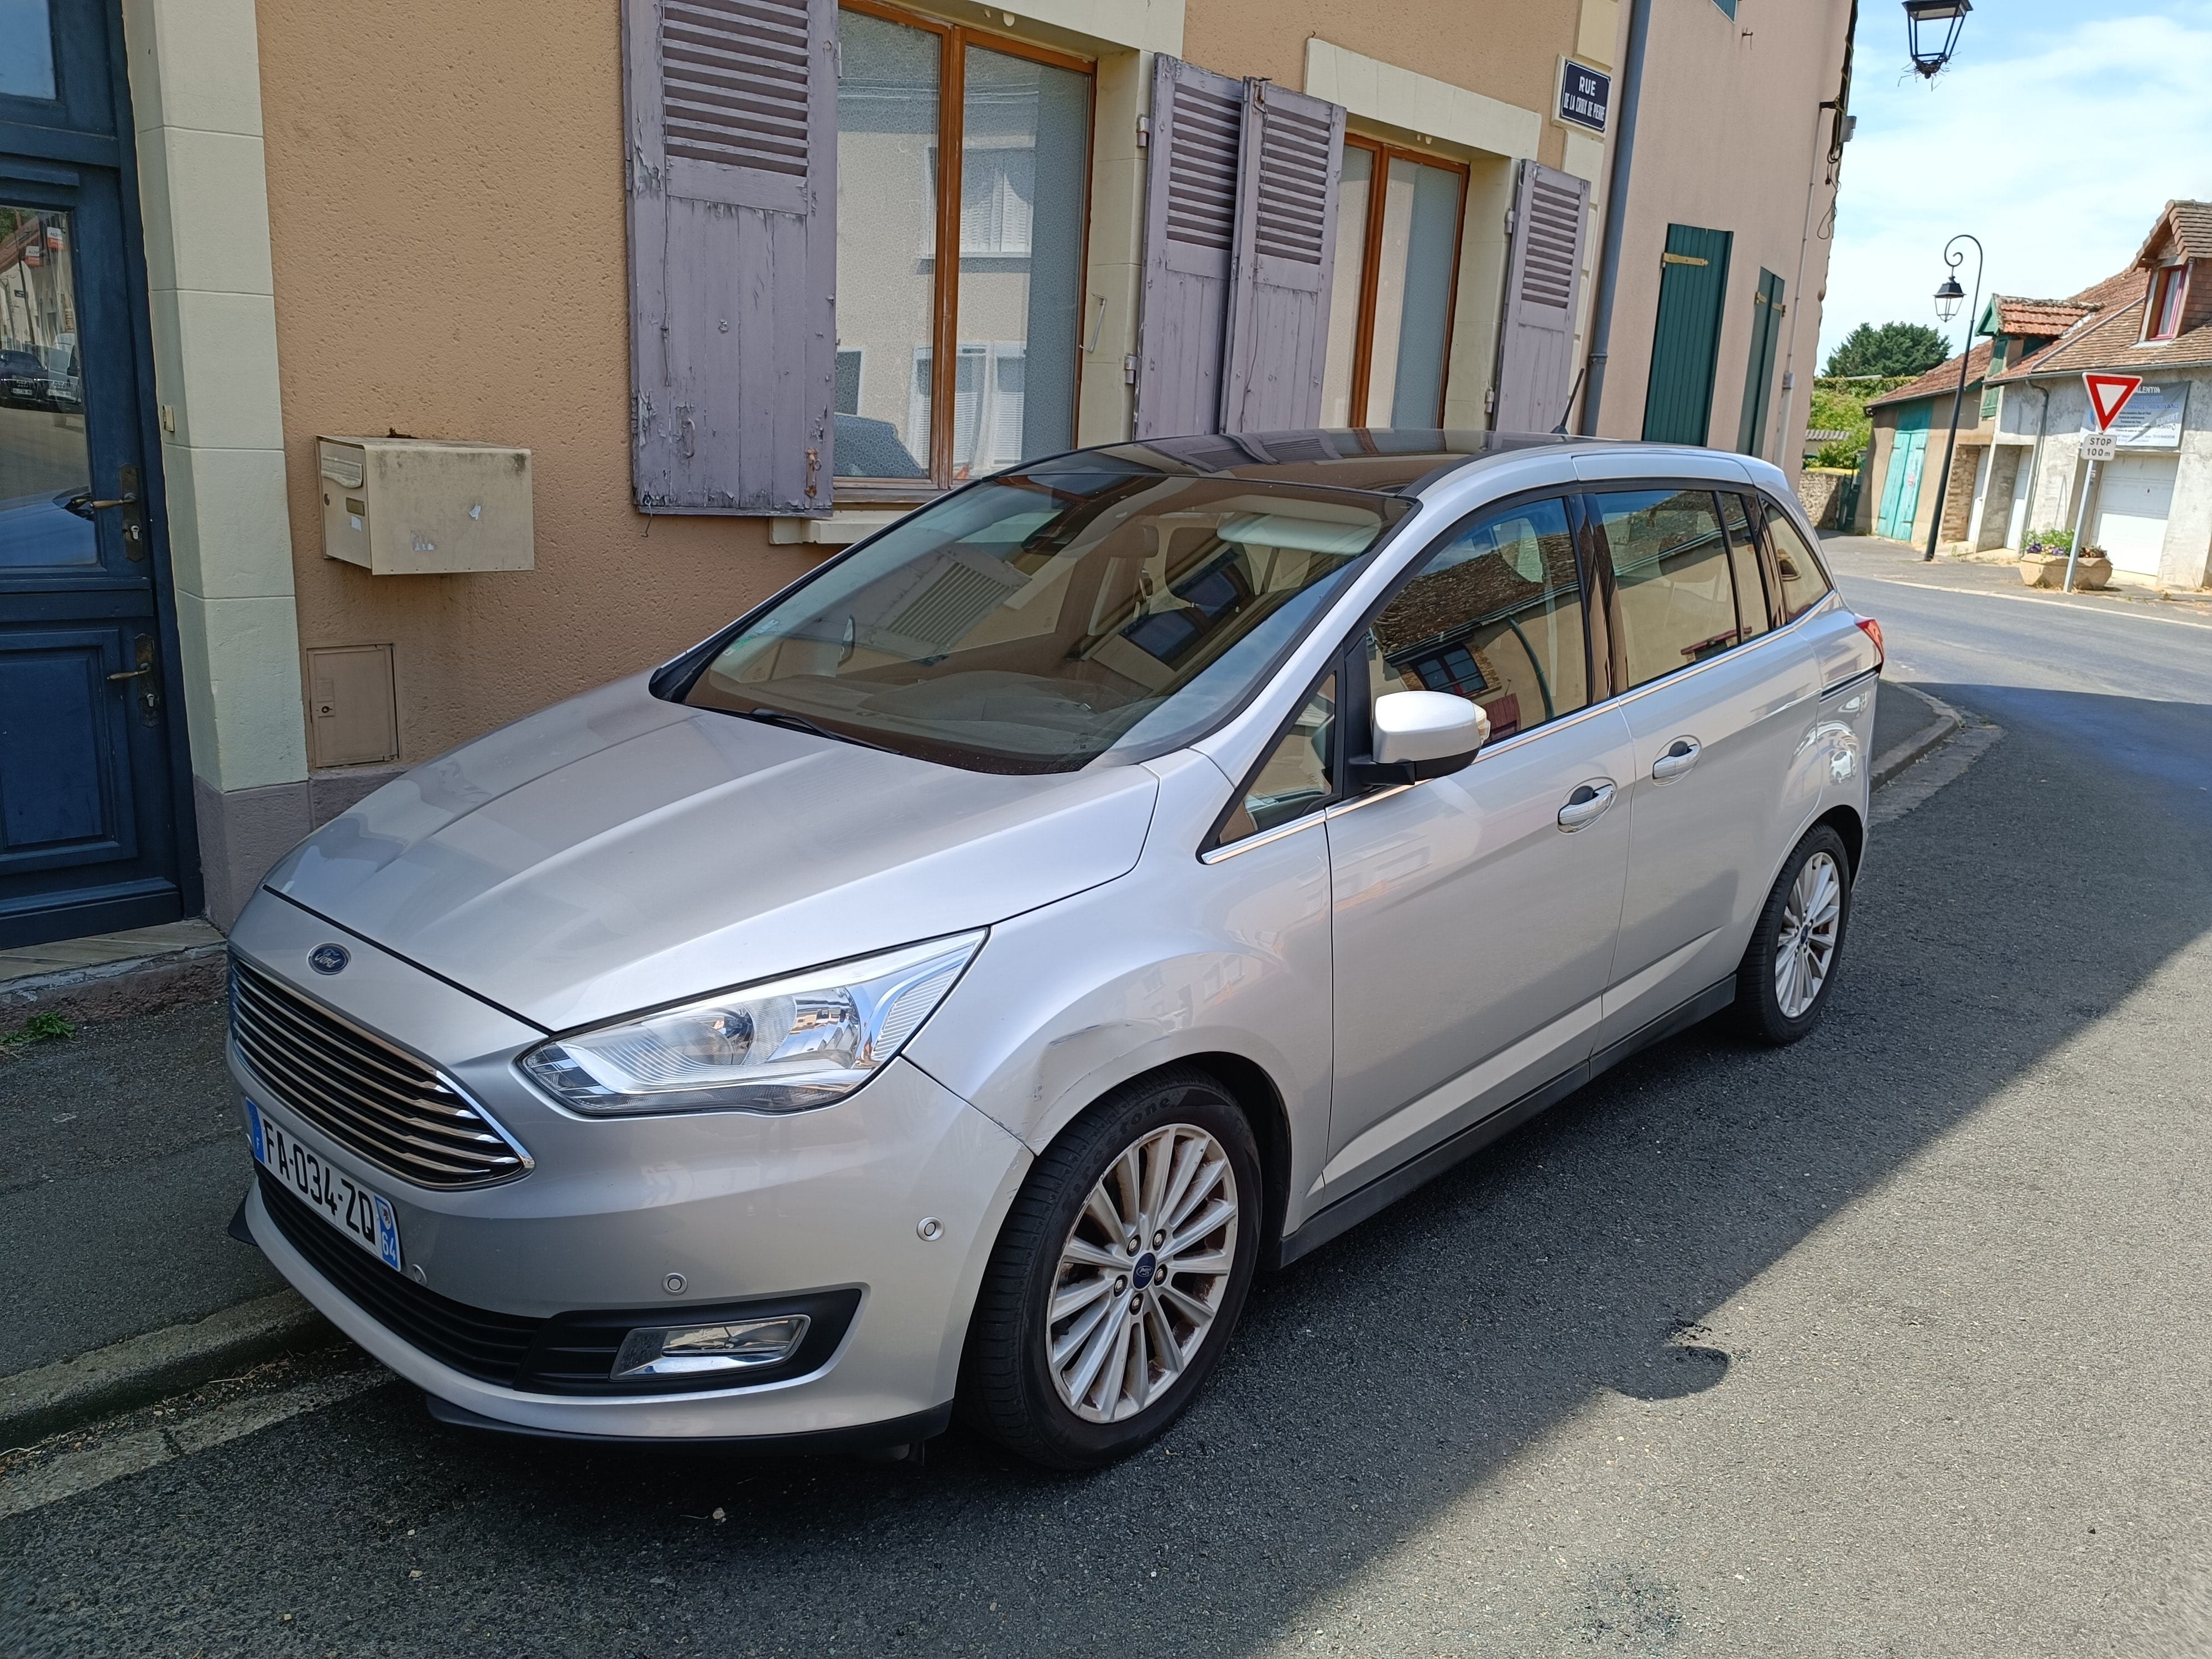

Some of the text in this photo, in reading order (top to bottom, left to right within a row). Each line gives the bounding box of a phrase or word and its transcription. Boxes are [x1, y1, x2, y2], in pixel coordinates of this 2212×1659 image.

[1578, 76, 1596, 96] RUE
[1563, 92, 1570, 109] DE
[1569, 95, 1575, 111] LA
[1587, 101, 1593, 117] DE
[2089, 437, 2111, 446] STOP
[314, 948, 341, 968] Ford
[256, 1136, 260, 1150] F
[263, 1118, 376, 1246] FA-034-ZQ
[382, 1231, 396, 1261] 64
